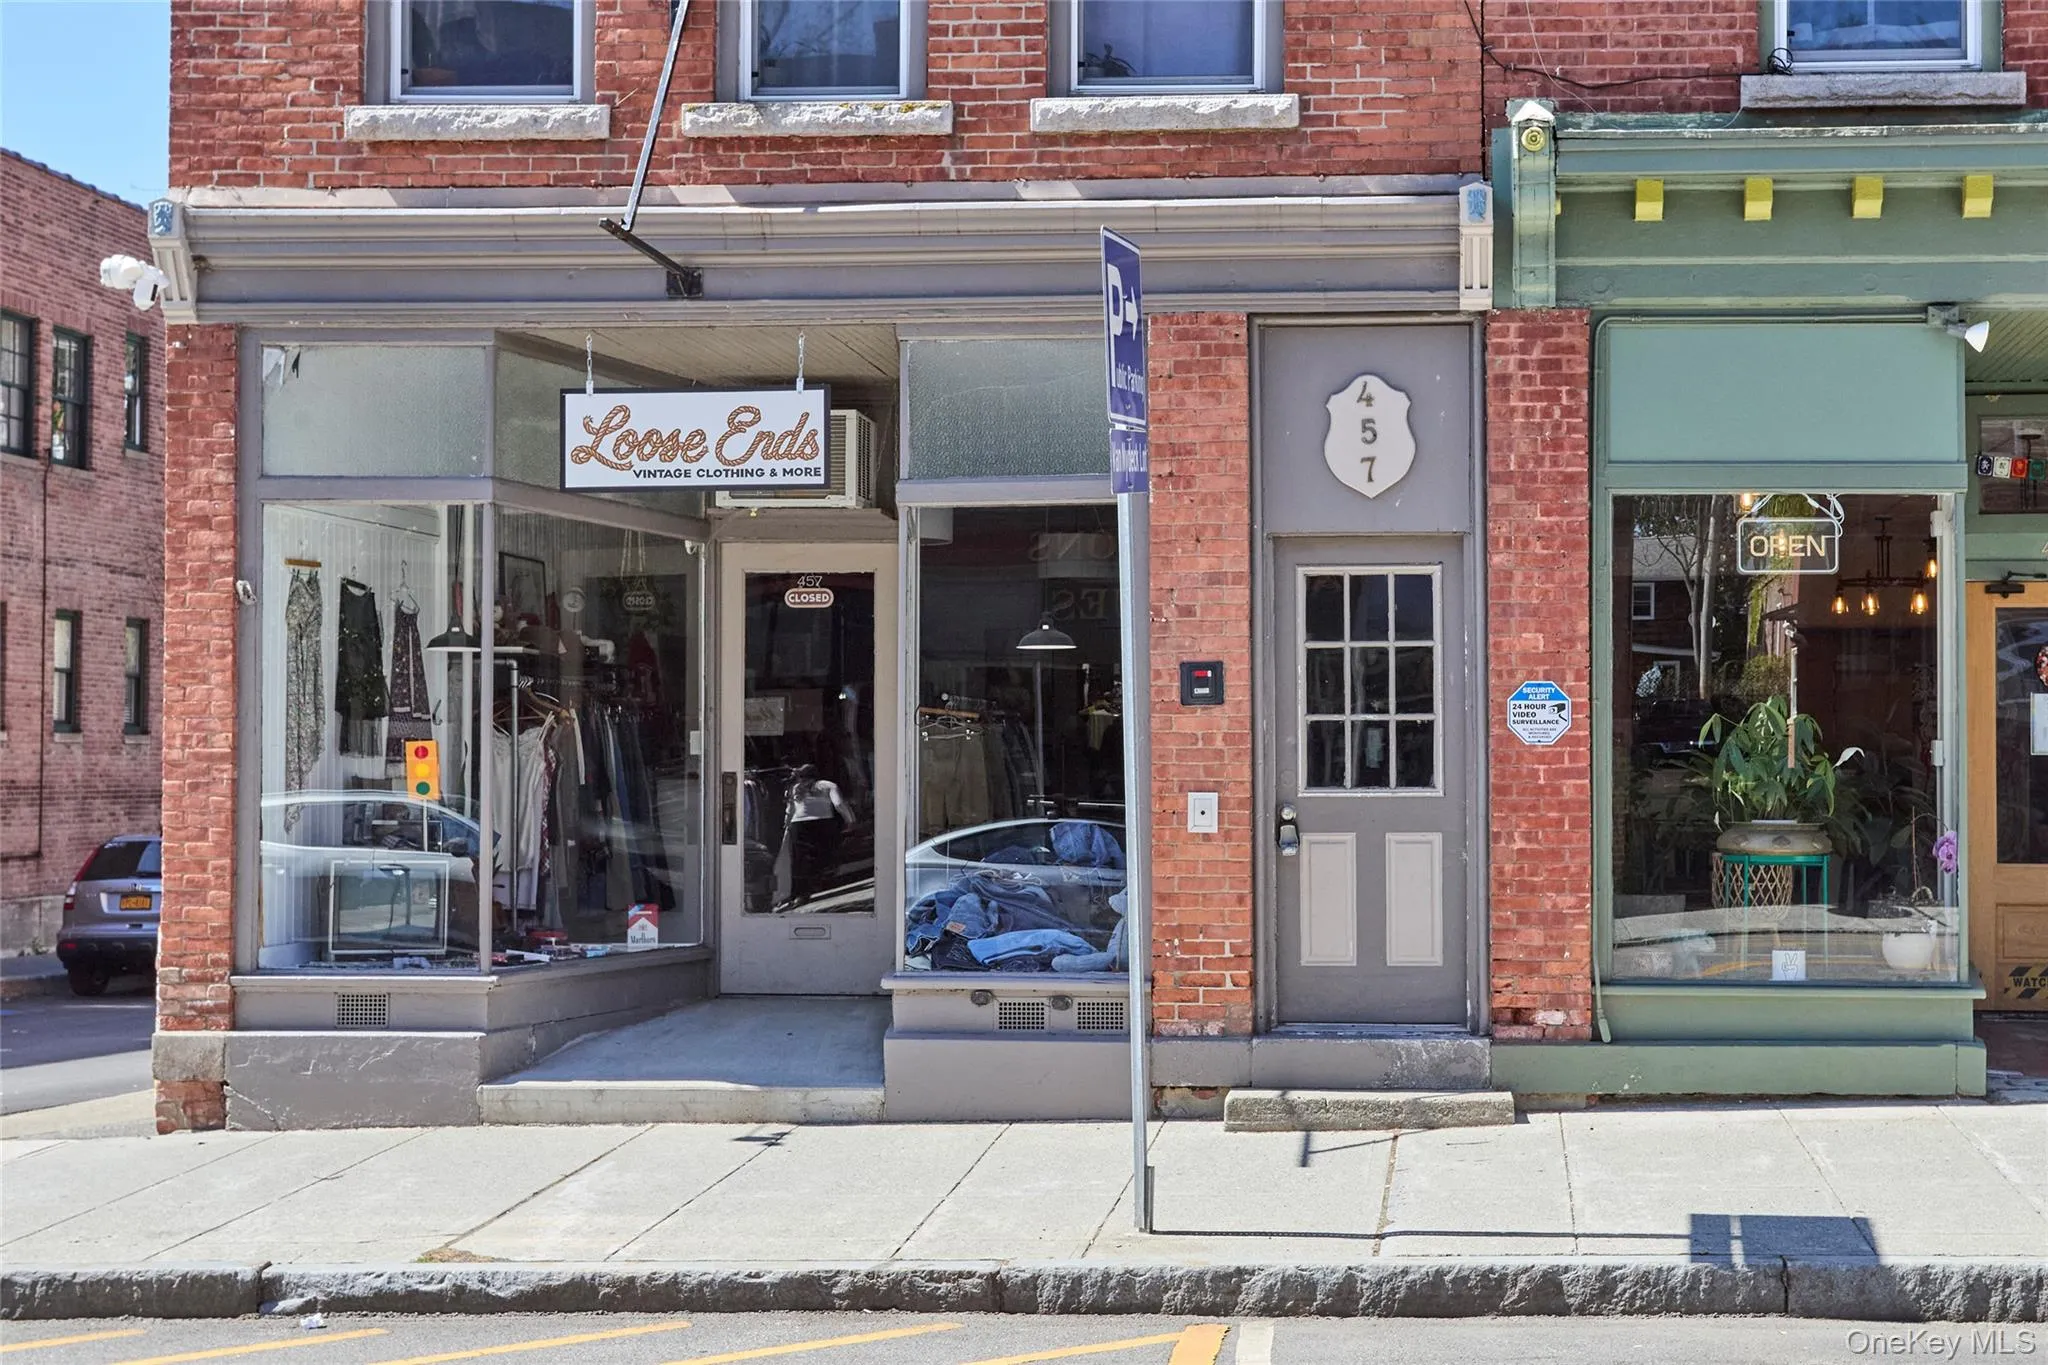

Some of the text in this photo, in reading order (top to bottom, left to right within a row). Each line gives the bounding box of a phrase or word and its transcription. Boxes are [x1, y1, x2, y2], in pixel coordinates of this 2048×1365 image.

[571, 404, 819, 471] Loose Ends
[633, 467, 822, 479] VINTAGE CLOTHING & MORE
[1750, 535, 1825, 557] OPEN
[797, 575, 823, 586] 457
[788, 593, 830, 602] CLOSED
[2013, 977, 2048, 987] WATC
